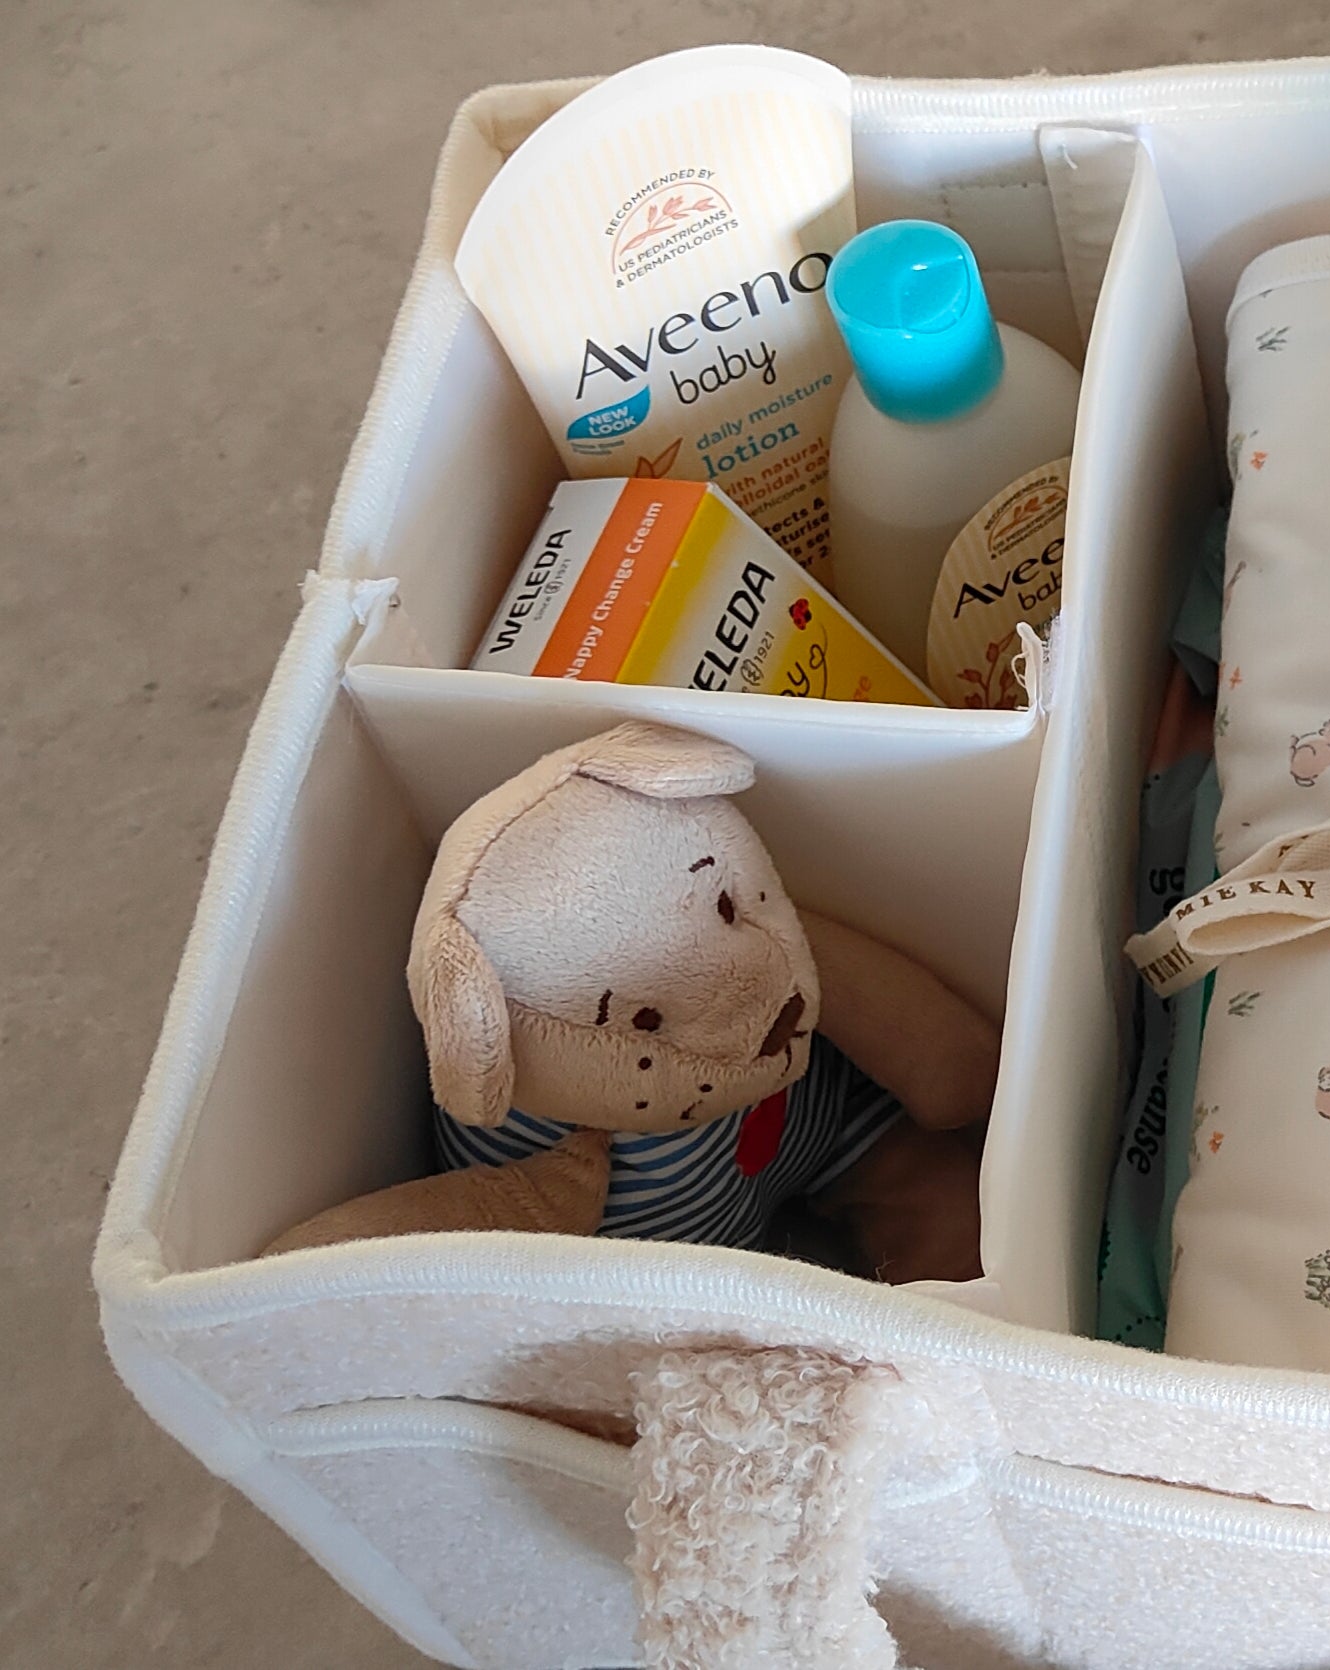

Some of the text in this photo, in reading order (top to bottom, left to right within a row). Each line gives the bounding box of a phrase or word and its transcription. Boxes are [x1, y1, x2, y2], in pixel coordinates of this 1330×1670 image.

[605, 168, 715, 236] RECOMMENDED BY
[618, 210, 727, 272] US PEDIATRICIANS
[627, 219, 739, 282] DERMATOLOGISTS
[576, 252, 834, 400] Aveeno
[669, 341, 776, 405] baby
[588, 405, 628, 426] NEW
[588, 416, 637, 436] LOOK
[696, 373, 833, 450] daily moisture
[701, 421, 800, 479] lotion
[761, 437, 824, 480] natural
[763, 507, 808, 536] tects
[488, 529, 572, 654] WELEDA
[563, 501, 663, 680] Nappy Change Cream
[688, 561, 775, 691] ELEDA
[753, 630, 775, 664] 1921
[1249, 878, 1316, 899] KAY
